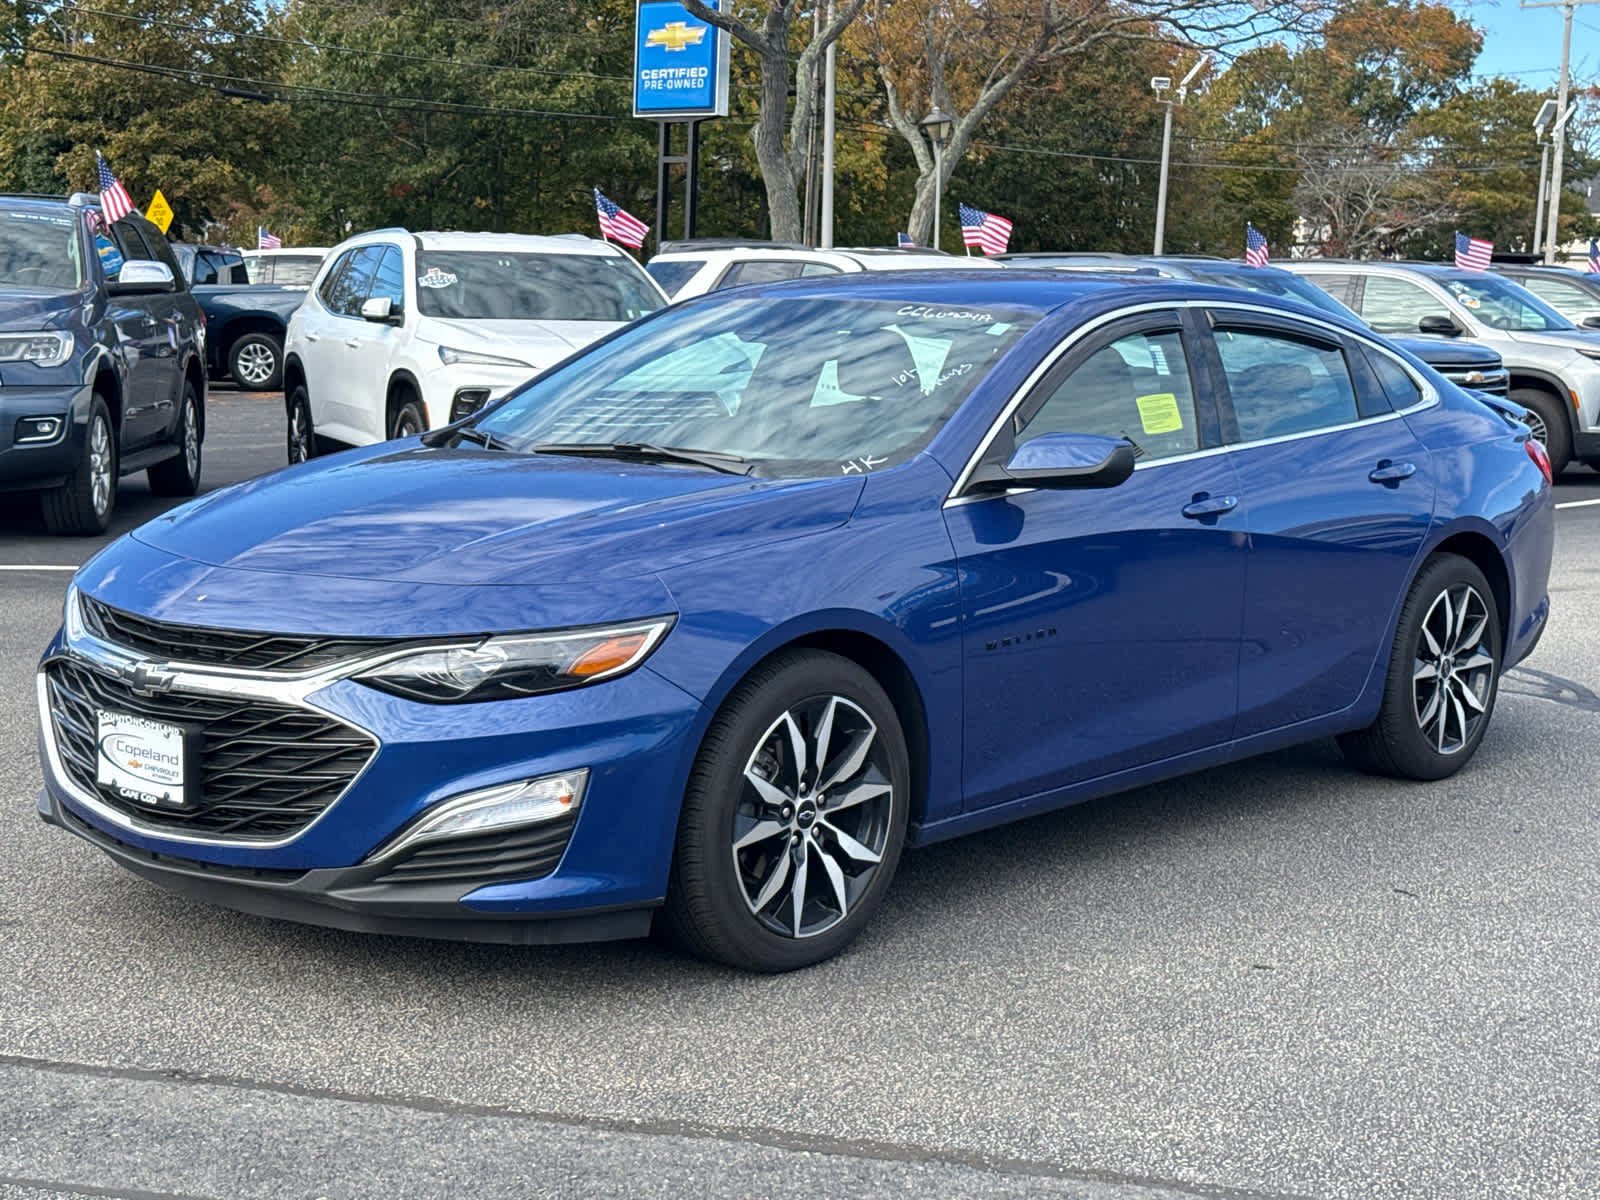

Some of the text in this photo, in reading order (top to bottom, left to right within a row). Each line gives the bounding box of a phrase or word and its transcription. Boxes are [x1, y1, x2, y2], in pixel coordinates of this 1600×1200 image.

[641, 67, 708, 79] CERTIFIED
[644, 79, 704, 90] PRE-OWNED
[116, 740, 179, 765] Copeland
[140, 792, 158, 804] COD
